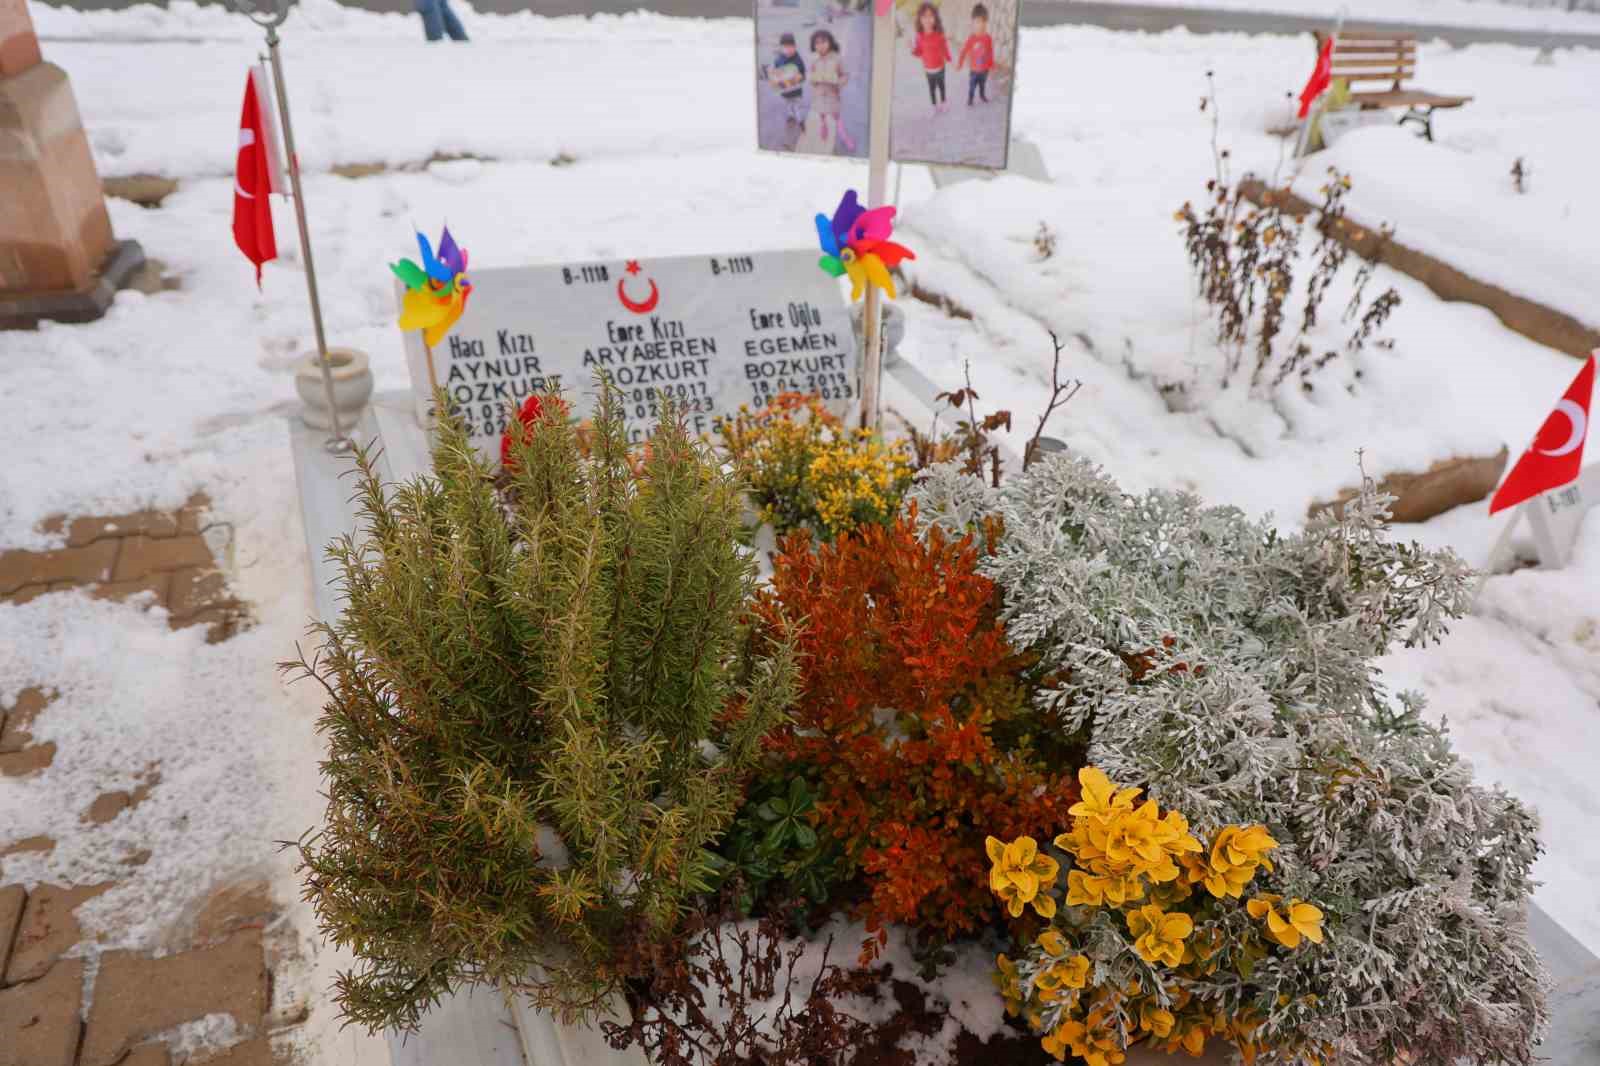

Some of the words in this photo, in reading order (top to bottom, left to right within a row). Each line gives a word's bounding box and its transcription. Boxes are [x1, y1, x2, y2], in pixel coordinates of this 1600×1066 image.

[744, 332, 838, 358] EGEMEN
[448, 356, 542, 383] AYNUR
[744, 353, 847, 380] BOZKURT
